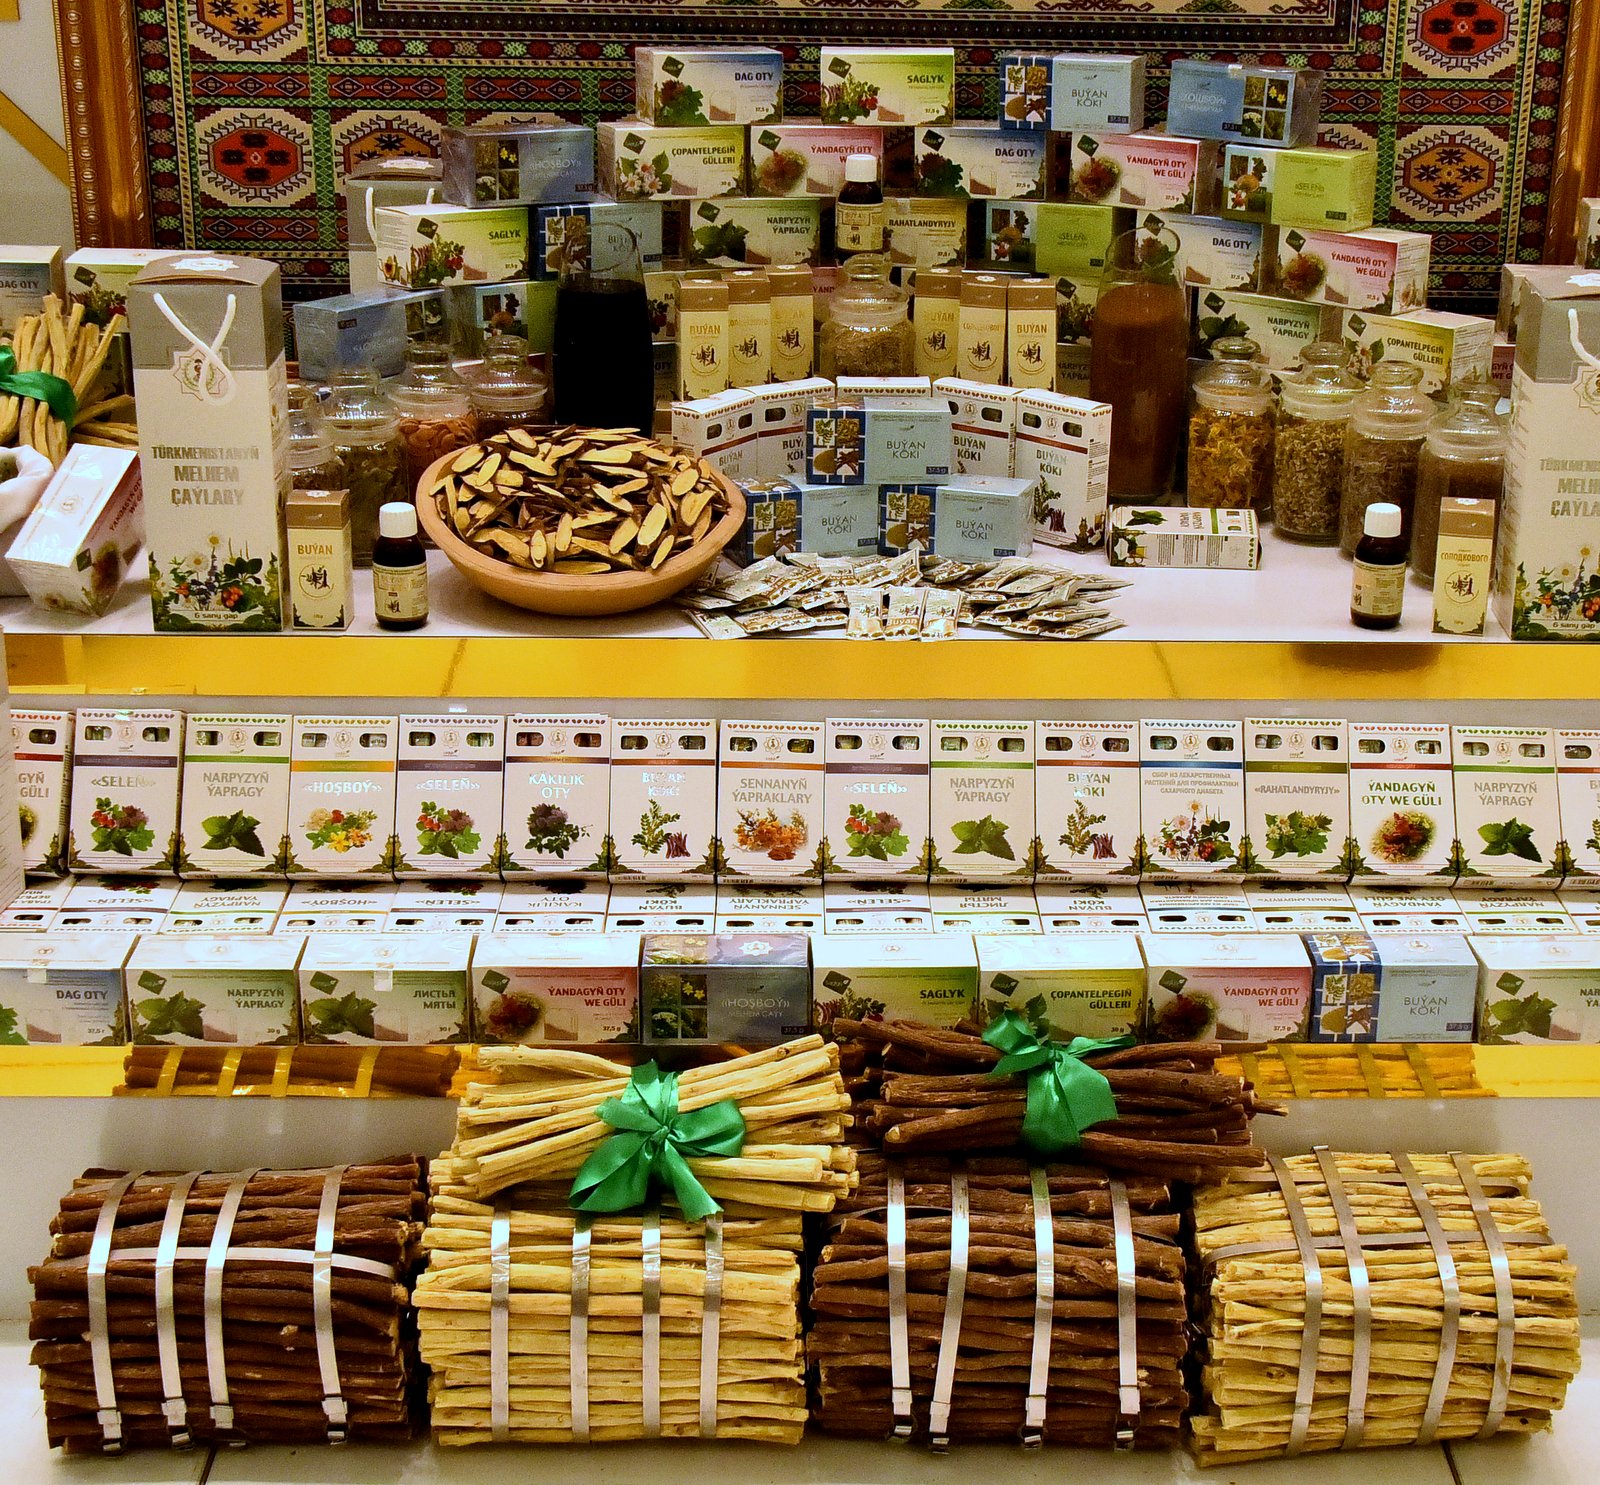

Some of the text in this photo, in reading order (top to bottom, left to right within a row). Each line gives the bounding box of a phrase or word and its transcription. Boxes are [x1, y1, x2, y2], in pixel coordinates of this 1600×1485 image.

[734, 72, 774, 82] DAG OTY
[907, 74, 945, 84] SAGLYK
[1071, 87, 1108, 99] BUÝAN
[811, 144, 873, 154] ÝANDAGYŇ OTY
[995, 148, 1035, 158] DAG OTY
[702, 155, 736, 165] GÜLLERI
[1126, 155, 1187, 169] ÝANDAGYŇ OTY
[1153, 168, 1186, 178] WE GÜLI
[766, 215, 811, 225] NARPYZYŇ
[889, 218, 956, 229] RAHATLANDYRYJY
[488, 230, 521, 240] SAGLYK
[772, 225, 810, 235] ÝAPRAGY
[1212, 237, 1252, 250] DAG OTY
[1331, 252, 1388, 268] ÝANDAGYŇ OTY
[1355, 267, 1387, 279] WE GÜLI
[20, 280, 39, 290] OTY
[1017, 322, 1048, 334] BUÝAN
[1413, 351, 1444, 365] GÜLLERI
[886, 438, 926, 450] BUÝAN
[953, 434, 986, 451] BUÝAN
[892, 448, 920, 459] KÖKI
[957, 447, 982, 462] KÖKI
[1036, 448, 1067, 466] BUÝAN
[174, 466, 240, 483] MELHEM
[1039, 462, 1062, 477] KÖKI
[1557, 478, 1600, 494] MELH
[171, 486, 244, 507] ÇAÝLARY
[1550, 497, 1600, 518] ÇAÝLA
[821, 514, 858, 526] BUÝAN
[955, 517, 993, 532] BUÝAN
[826, 523, 852, 535] KÖKI
[961, 528, 988, 541] KÖKI
[297, 542, 333, 555] BUÝAN
[1441, 552, 1488, 563] СОЛОДКОВОГО
[194, 610, 239, 621] 6 sany gap
[1560, 622, 1578, 630] sany
[1580, 623, 1596, 631] gap
[203, 769, 269, 784] NARPYZYŇ
[950, 776, 1015, 789] NARPYZYŇ
[740, 776, 807, 791] SENNANYŇ
[1368, 779, 1436, 793] ÝANDAGYŇ
[1474, 781, 1537, 794] NARPYZYŇ
[20, 784, 49, 798] GÜLI
[208, 783, 264, 798] ÝAPRAGY
[541, 786, 571, 799] OTY
[955, 790, 1010, 803] ÝAPRAGY
[732, 790, 813, 804] ÝAPRAKLARY
[1361, 792, 1442, 806] OTY WE GÜLI
[1479, 794, 1534, 807] ÝAPRAGY
[56, 989, 108, 1001] DAG OTY
[227, 986, 284, 998] NARPYZYŇ
[413, 989, 456, 1000] ЛИСТЬЯ
[548, 984, 626, 998] ÝANDAGYŇ OTY
[919, 988, 965, 1000] SAGLYK
[1050, 987, 1132, 1002] ÇOPANTELPEGIŇ
[1223, 984, 1300, 998] ÝANDAGYŇ OTY
[236, 998, 285, 1010] ÝAPRAGY
[423, 1000, 456, 1010] МЯТЫ
[584, 996, 627, 1007] WE GÜLI
[1090, 998, 1132, 1010] GÜLLERI
[1258, 996, 1299, 1008] WE GÜLI
[1403, 994, 1448, 1008] BUÝAN
[1409, 1004, 1441, 1016] KÖKI
